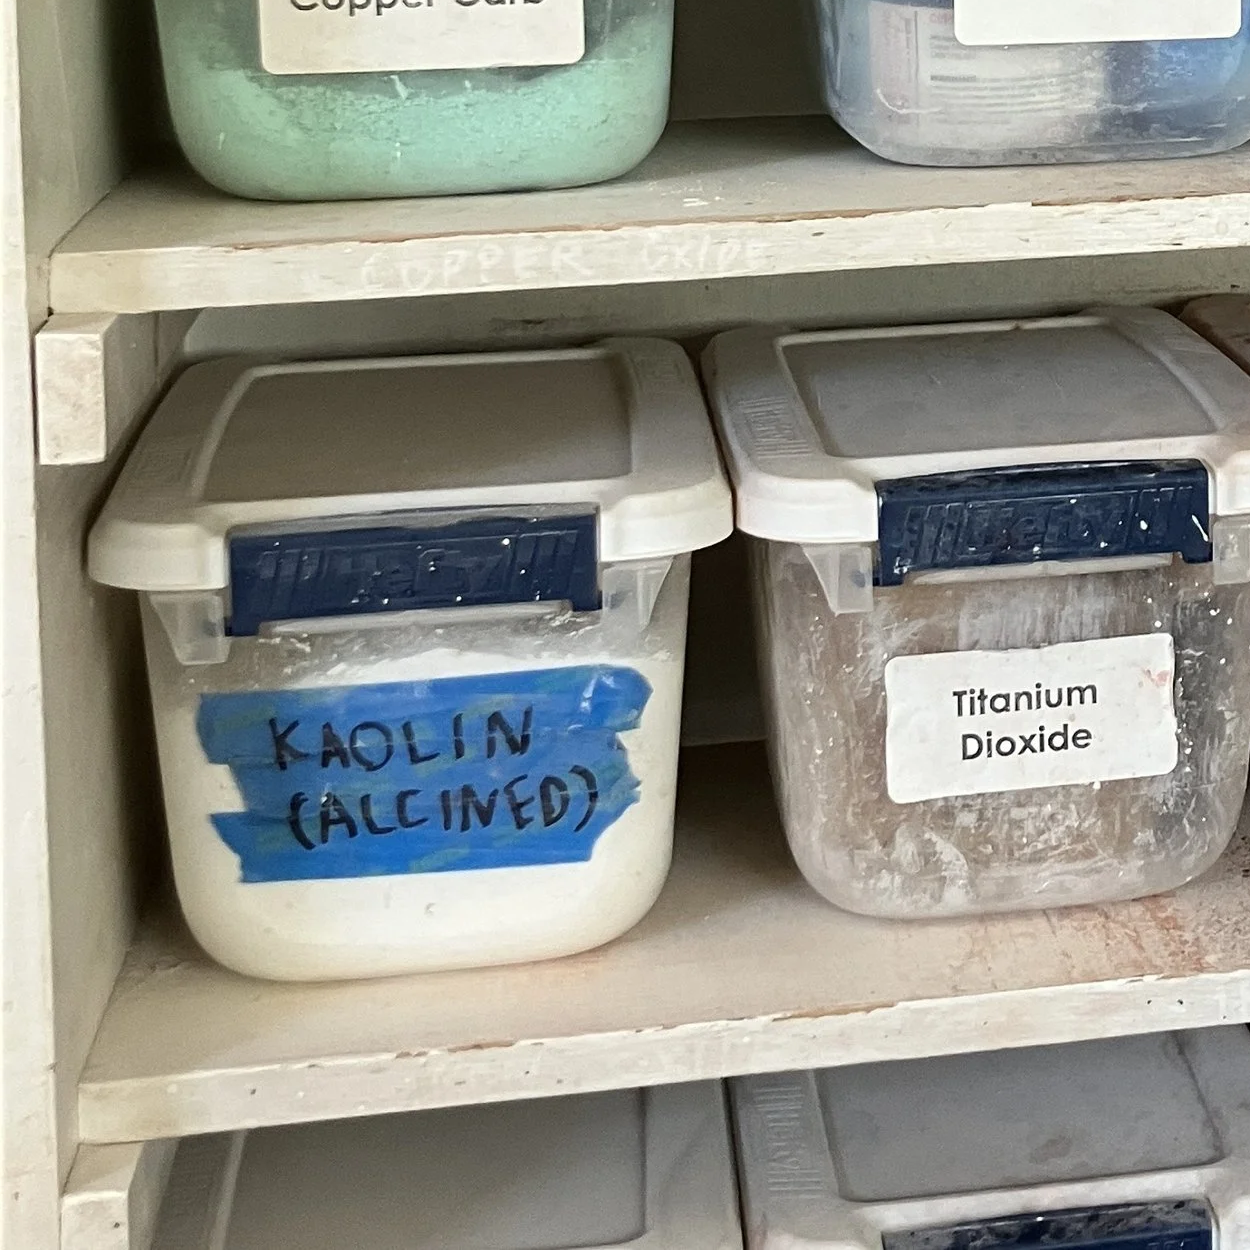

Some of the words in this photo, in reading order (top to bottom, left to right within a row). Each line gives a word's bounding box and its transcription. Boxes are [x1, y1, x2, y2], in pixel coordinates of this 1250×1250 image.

[952, 682, 1098, 717] Titanium
[268, 705, 534, 773] KAOLIN
[960, 723, 1093, 762] Dioxide
